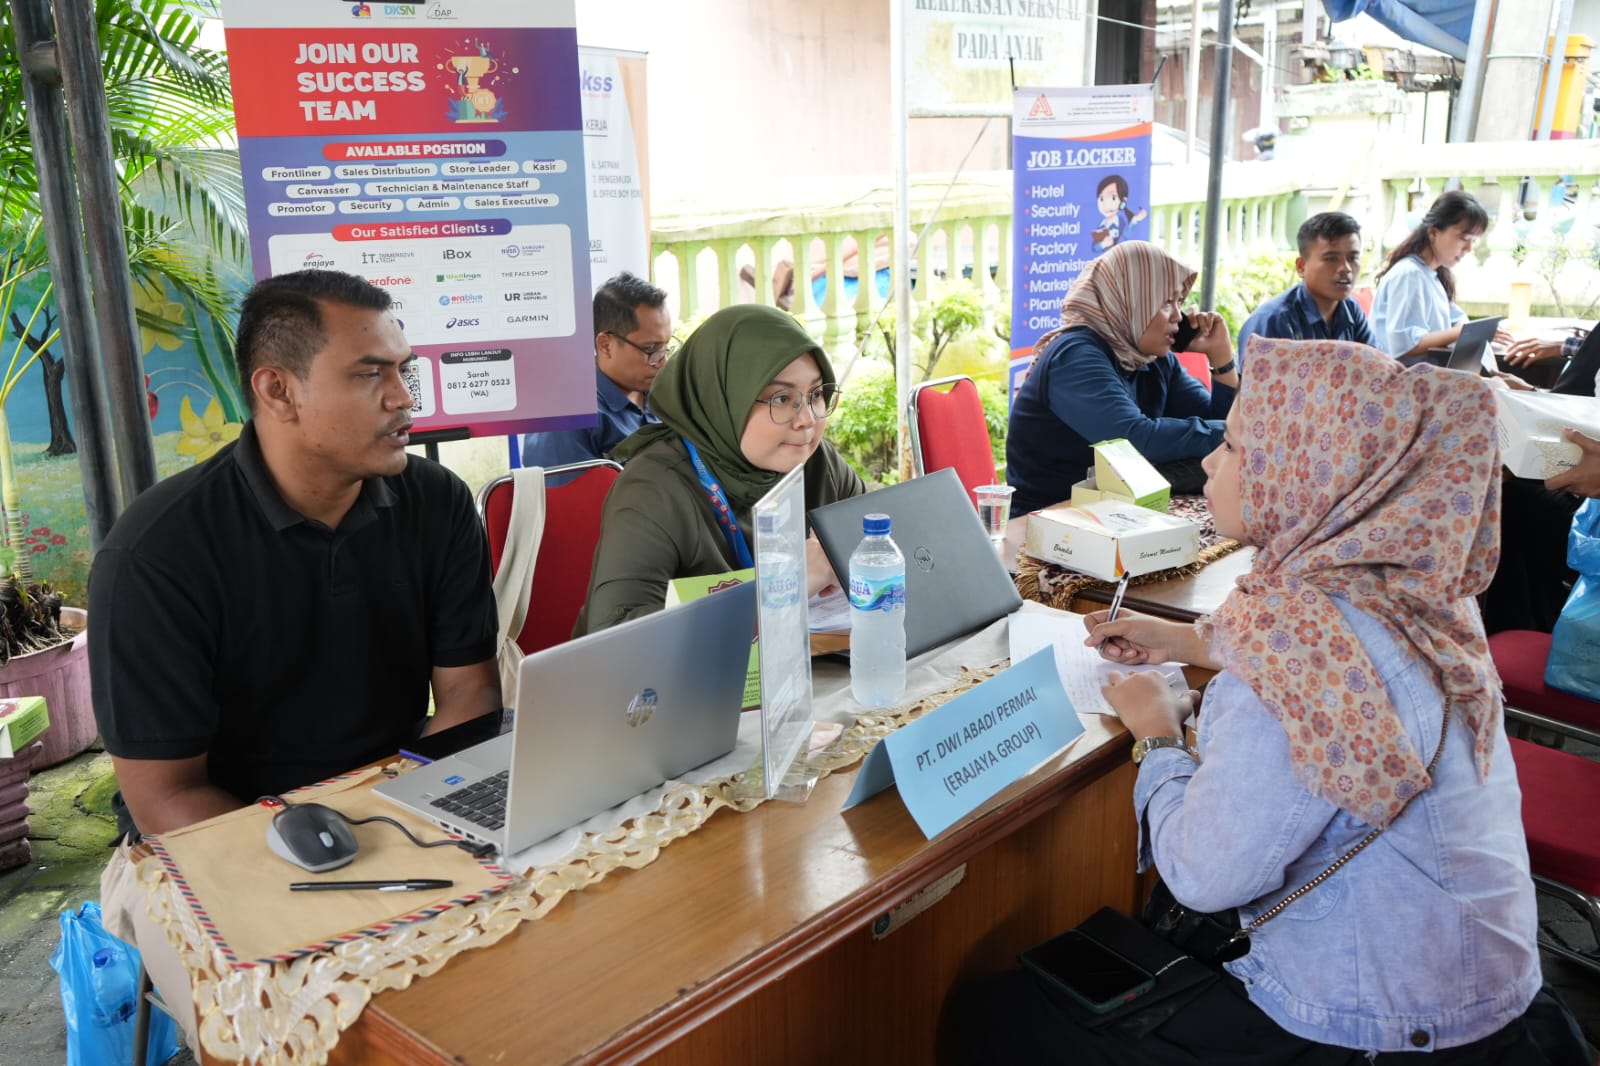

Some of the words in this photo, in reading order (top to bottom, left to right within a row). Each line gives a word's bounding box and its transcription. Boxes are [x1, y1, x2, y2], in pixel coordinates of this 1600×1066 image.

[384, 5, 416, 15] DKSN
[434, 9, 452, 17] DAP
[956, 32, 999, 60] PADA
[1002, 34, 1044, 61] ANAK
[295, 43, 357, 66] JOIN
[362, 43, 419, 64] OUR
[297, 71, 426, 93] SUCCESS
[582, 69, 613, 93] kss
[299, 101, 377, 122] TEAM
[346, 144, 421, 158] AVAILABLE
[423, 143, 486, 156] POSITION
[1026, 150, 1062, 169] JOB
[1066, 146, 1137, 167] LOCKER
[342, 168, 369, 177] Sales
[371, 166, 431, 176] Distribution
[449, 165, 476, 174] Store
[478, 163, 511, 173] Leader
[532, 162, 557, 172] Kasir
[271, 168, 322, 180] Frontliner
[297, 186, 350, 196] Canvasser
[375, 183, 430, 193] Technician
[432, 184, 439, 192] &
[441, 181, 504, 192] Maintenance
[1031, 184, 1065, 199] Hotel
[350, 201, 393, 211] Security
[417, 199, 450, 209] Admin
[474, 199, 500, 208] Sales
[502, 196, 549, 206] Executive
[277, 203, 326, 214] Promotor
[1031, 203, 1081, 219] Security
[351, 228, 377, 239] Our
[379, 224, 438, 238] Satisfied
[441, 223, 488, 235] Clients
[1031, 221, 1081, 239] Hospital
[442, 248, 472, 260] iBox
[1030, 242, 1078, 257] Factory
[303, 259, 335, 269] erajaya
[531, 269, 549, 277] SHOP
[367, 276, 412, 287] erafone
[1029, 278, 1075, 294] Market
[451, 293, 483, 302] erablue
[504, 292, 521, 301] UR
[1029, 298, 1065, 312] Plant
[457, 317, 480, 327] asics
[506, 314, 549, 324] GARMIN
[1029, 315, 1066, 330] Office
[466, 370, 490, 379] Sarah
[447, 381, 467, 390] 0812
[469, 380, 489, 389] 6277
[490, 378, 511, 387] 0523
[470, 389, 489, 399] (WA)
[848, 578, 871, 597] QUA
[916, 754, 936, 772] PT.
[936, 732, 963, 760] DWI
[964, 710, 998, 744] ABADI
[996, 686, 1038, 723] PERMAI
[943, 750, 999, 797] (ERAJAYA
[996, 721, 1043, 759] GROUP)
